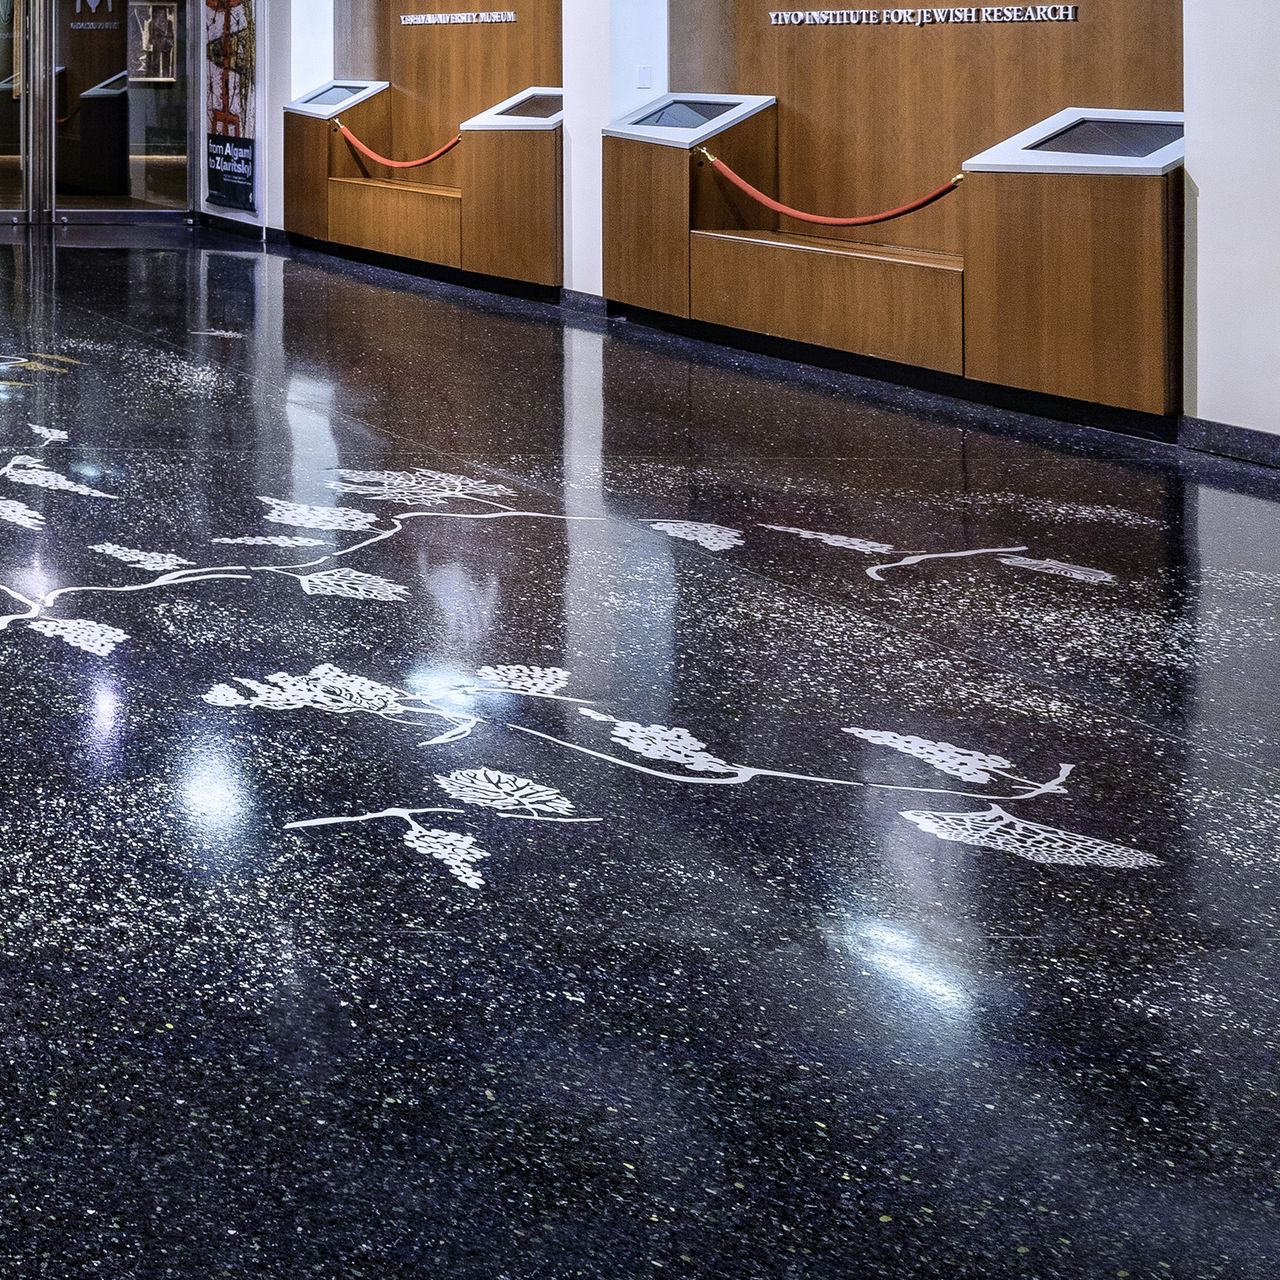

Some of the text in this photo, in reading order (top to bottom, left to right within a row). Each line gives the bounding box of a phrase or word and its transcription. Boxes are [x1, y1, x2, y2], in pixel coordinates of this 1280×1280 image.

[769, 4, 1075, 27] YIVO INSTITUTE FOR JEWISH RESEARCH
[209, 139, 224, 155] from
[209, 156, 215, 168] to
